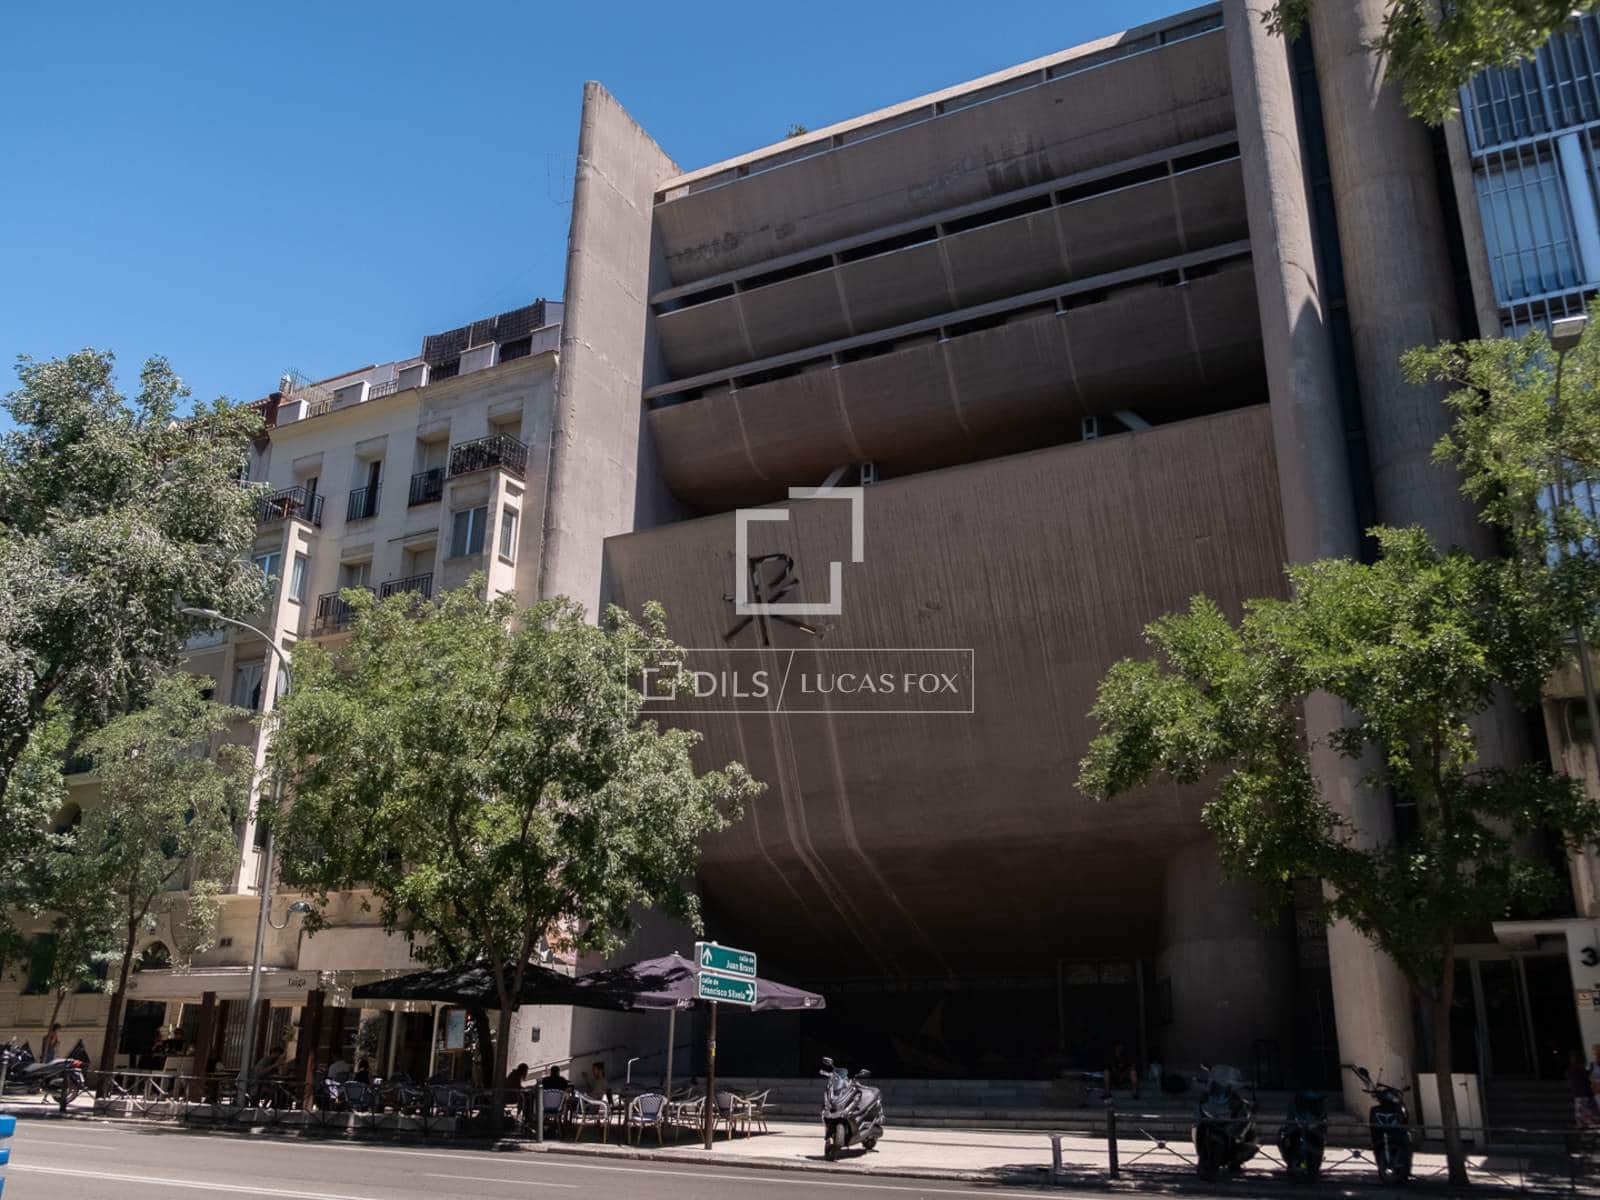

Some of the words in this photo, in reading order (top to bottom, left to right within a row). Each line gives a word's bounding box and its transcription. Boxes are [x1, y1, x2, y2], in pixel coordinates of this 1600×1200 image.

[726, 960, 739, 970] Juan
[739, 962, 754, 973] Bravo
[701, 985, 727, 996] Francisco
[728, 989, 746, 1000] Silvela
